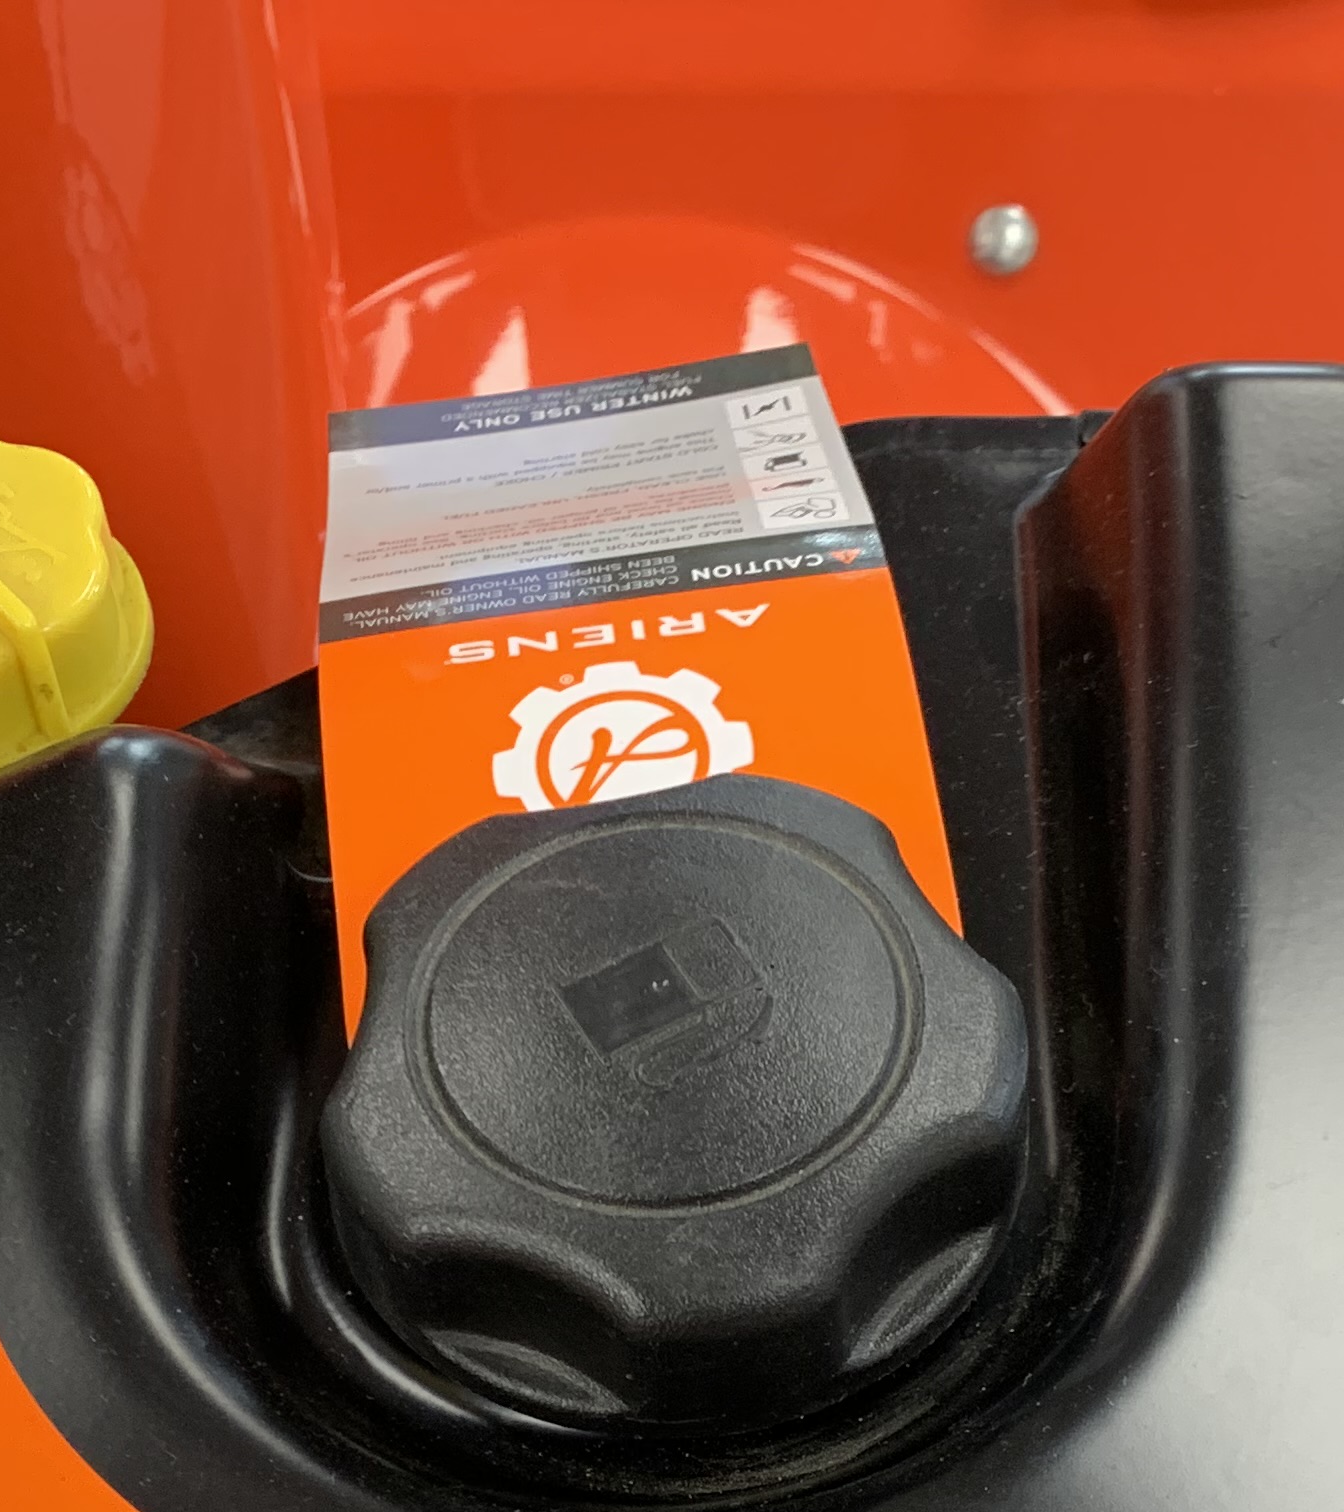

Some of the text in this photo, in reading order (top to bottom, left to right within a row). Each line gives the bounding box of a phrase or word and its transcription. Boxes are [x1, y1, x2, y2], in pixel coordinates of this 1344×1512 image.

[452, 384, 694, 433] WINTER USE ONLY
[544, 561, 623, 581] SHIPPED
[627, 553, 676, 569] BEEN
[689, 550, 825, 583] CAUTION
[546, 572, 613, 591] ENGINE
[616, 563, 678, 581] CHECK
[456, 573, 540, 593] WITHOUT
[576, 573, 680, 597] CAREFULLY
[394, 598, 432, 613] MAY
[435, 587, 503, 607] ENGINE
[520, 589, 571, 605] READ
[341, 605, 389, 622] HAVE
[445, 602, 771, 665] ARIENS
